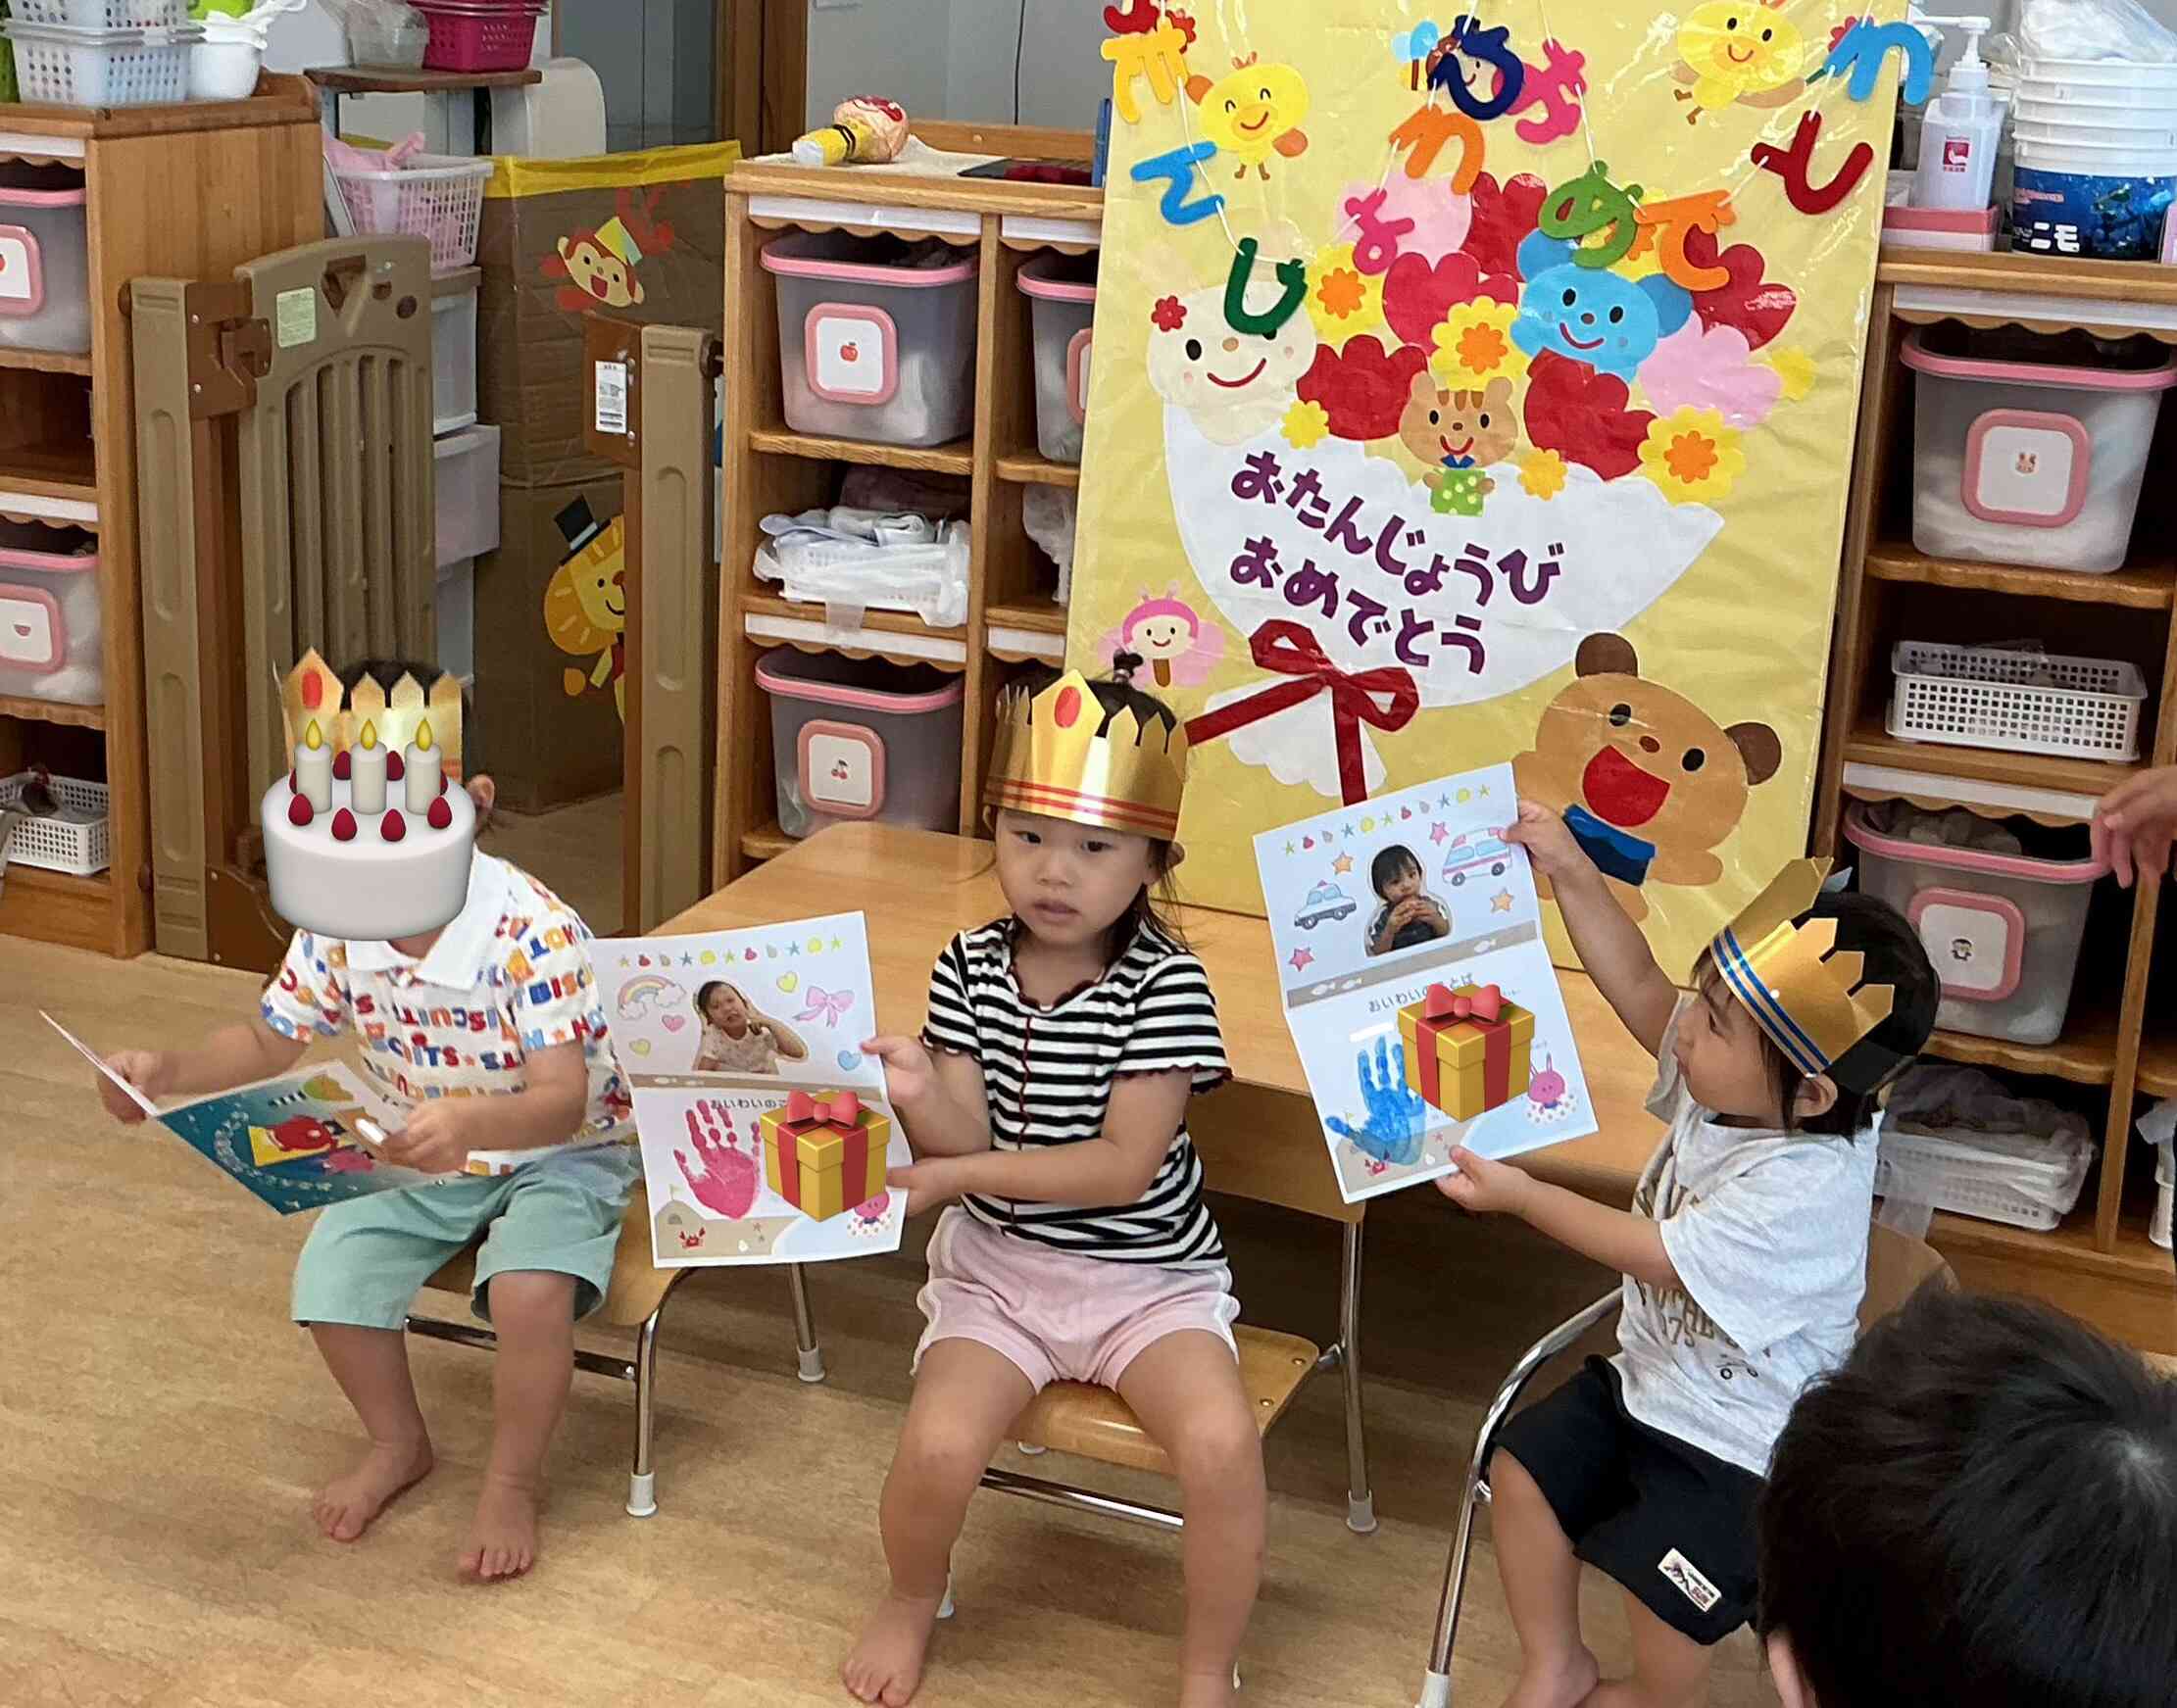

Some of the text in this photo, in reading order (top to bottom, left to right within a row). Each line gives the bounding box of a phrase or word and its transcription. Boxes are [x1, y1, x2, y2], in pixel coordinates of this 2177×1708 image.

[1231, 450, 1565, 606] おたんじょうび
[1230, 535, 1486, 675] おめでとう
